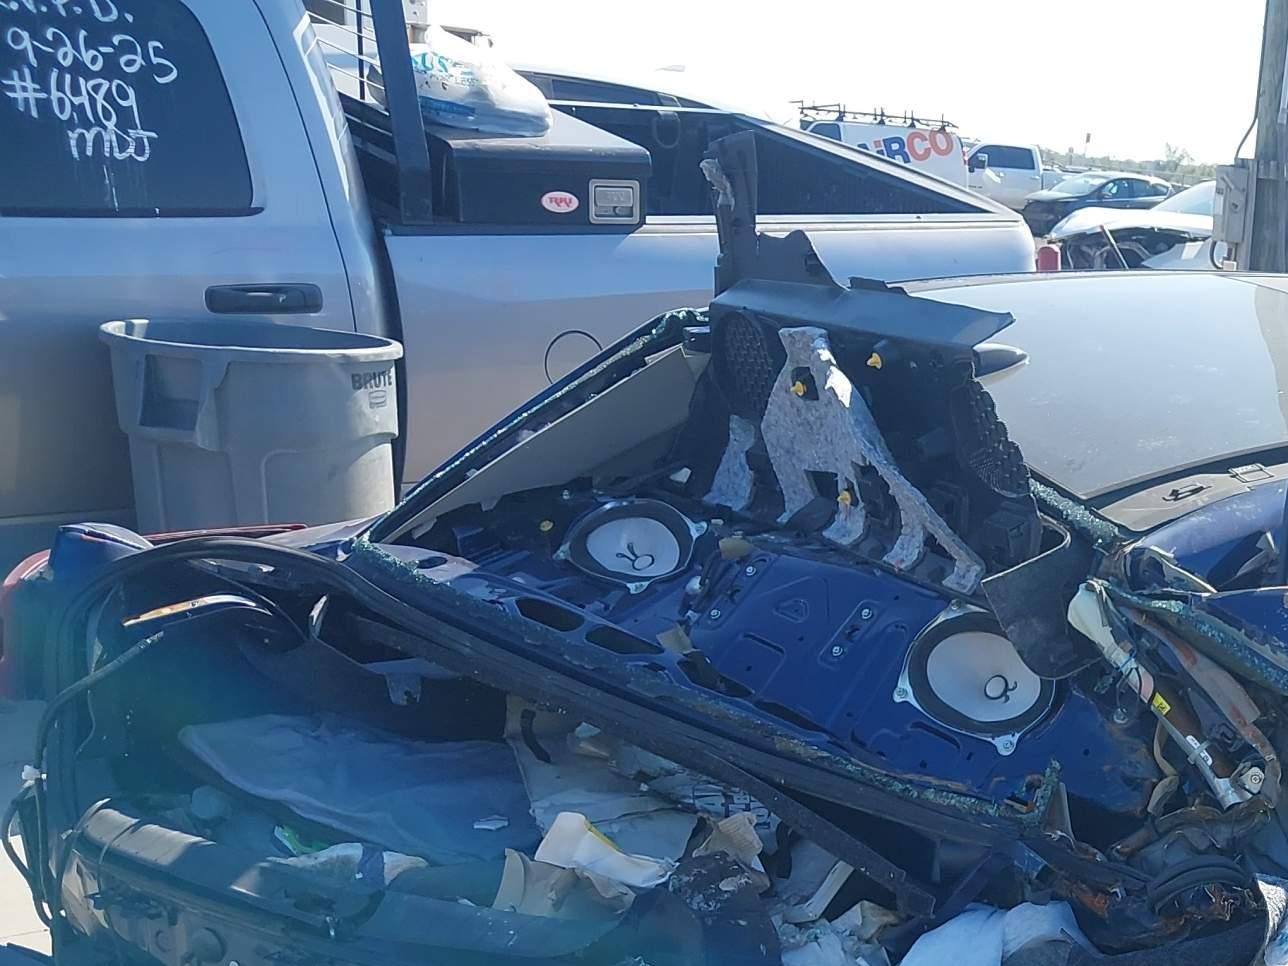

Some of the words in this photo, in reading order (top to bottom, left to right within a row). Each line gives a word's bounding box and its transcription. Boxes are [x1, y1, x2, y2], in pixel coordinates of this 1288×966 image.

[7, 27, 178, 84] 9-26-25
[1, 65, 141, 129] #6489
[351, 369, 393, 391] BRUTE
